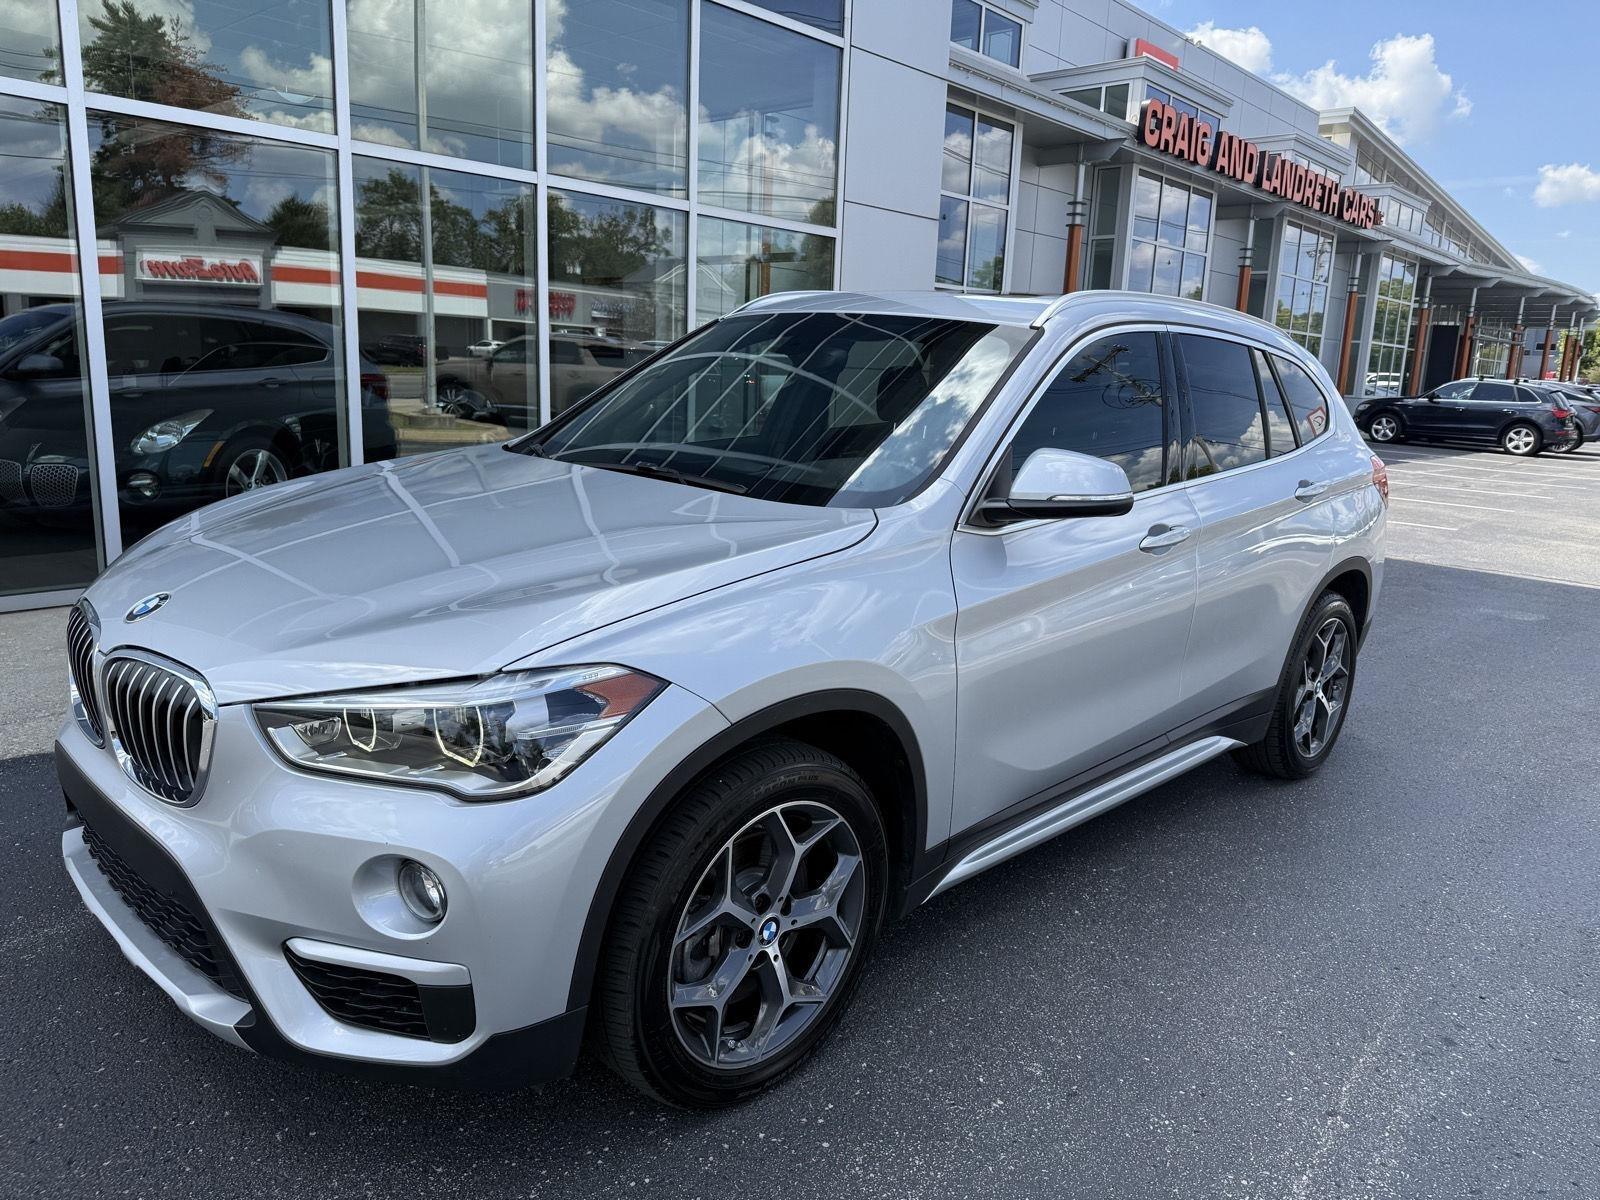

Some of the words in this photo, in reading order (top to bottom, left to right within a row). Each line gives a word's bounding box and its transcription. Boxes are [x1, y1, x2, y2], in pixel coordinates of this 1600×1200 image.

[1144, 98, 1212, 166] CRAIG
[1215, 131, 1257, 184] AND
[1262, 151, 1341, 217] LANDRETH
[1343, 187, 1376, 229] CARS
